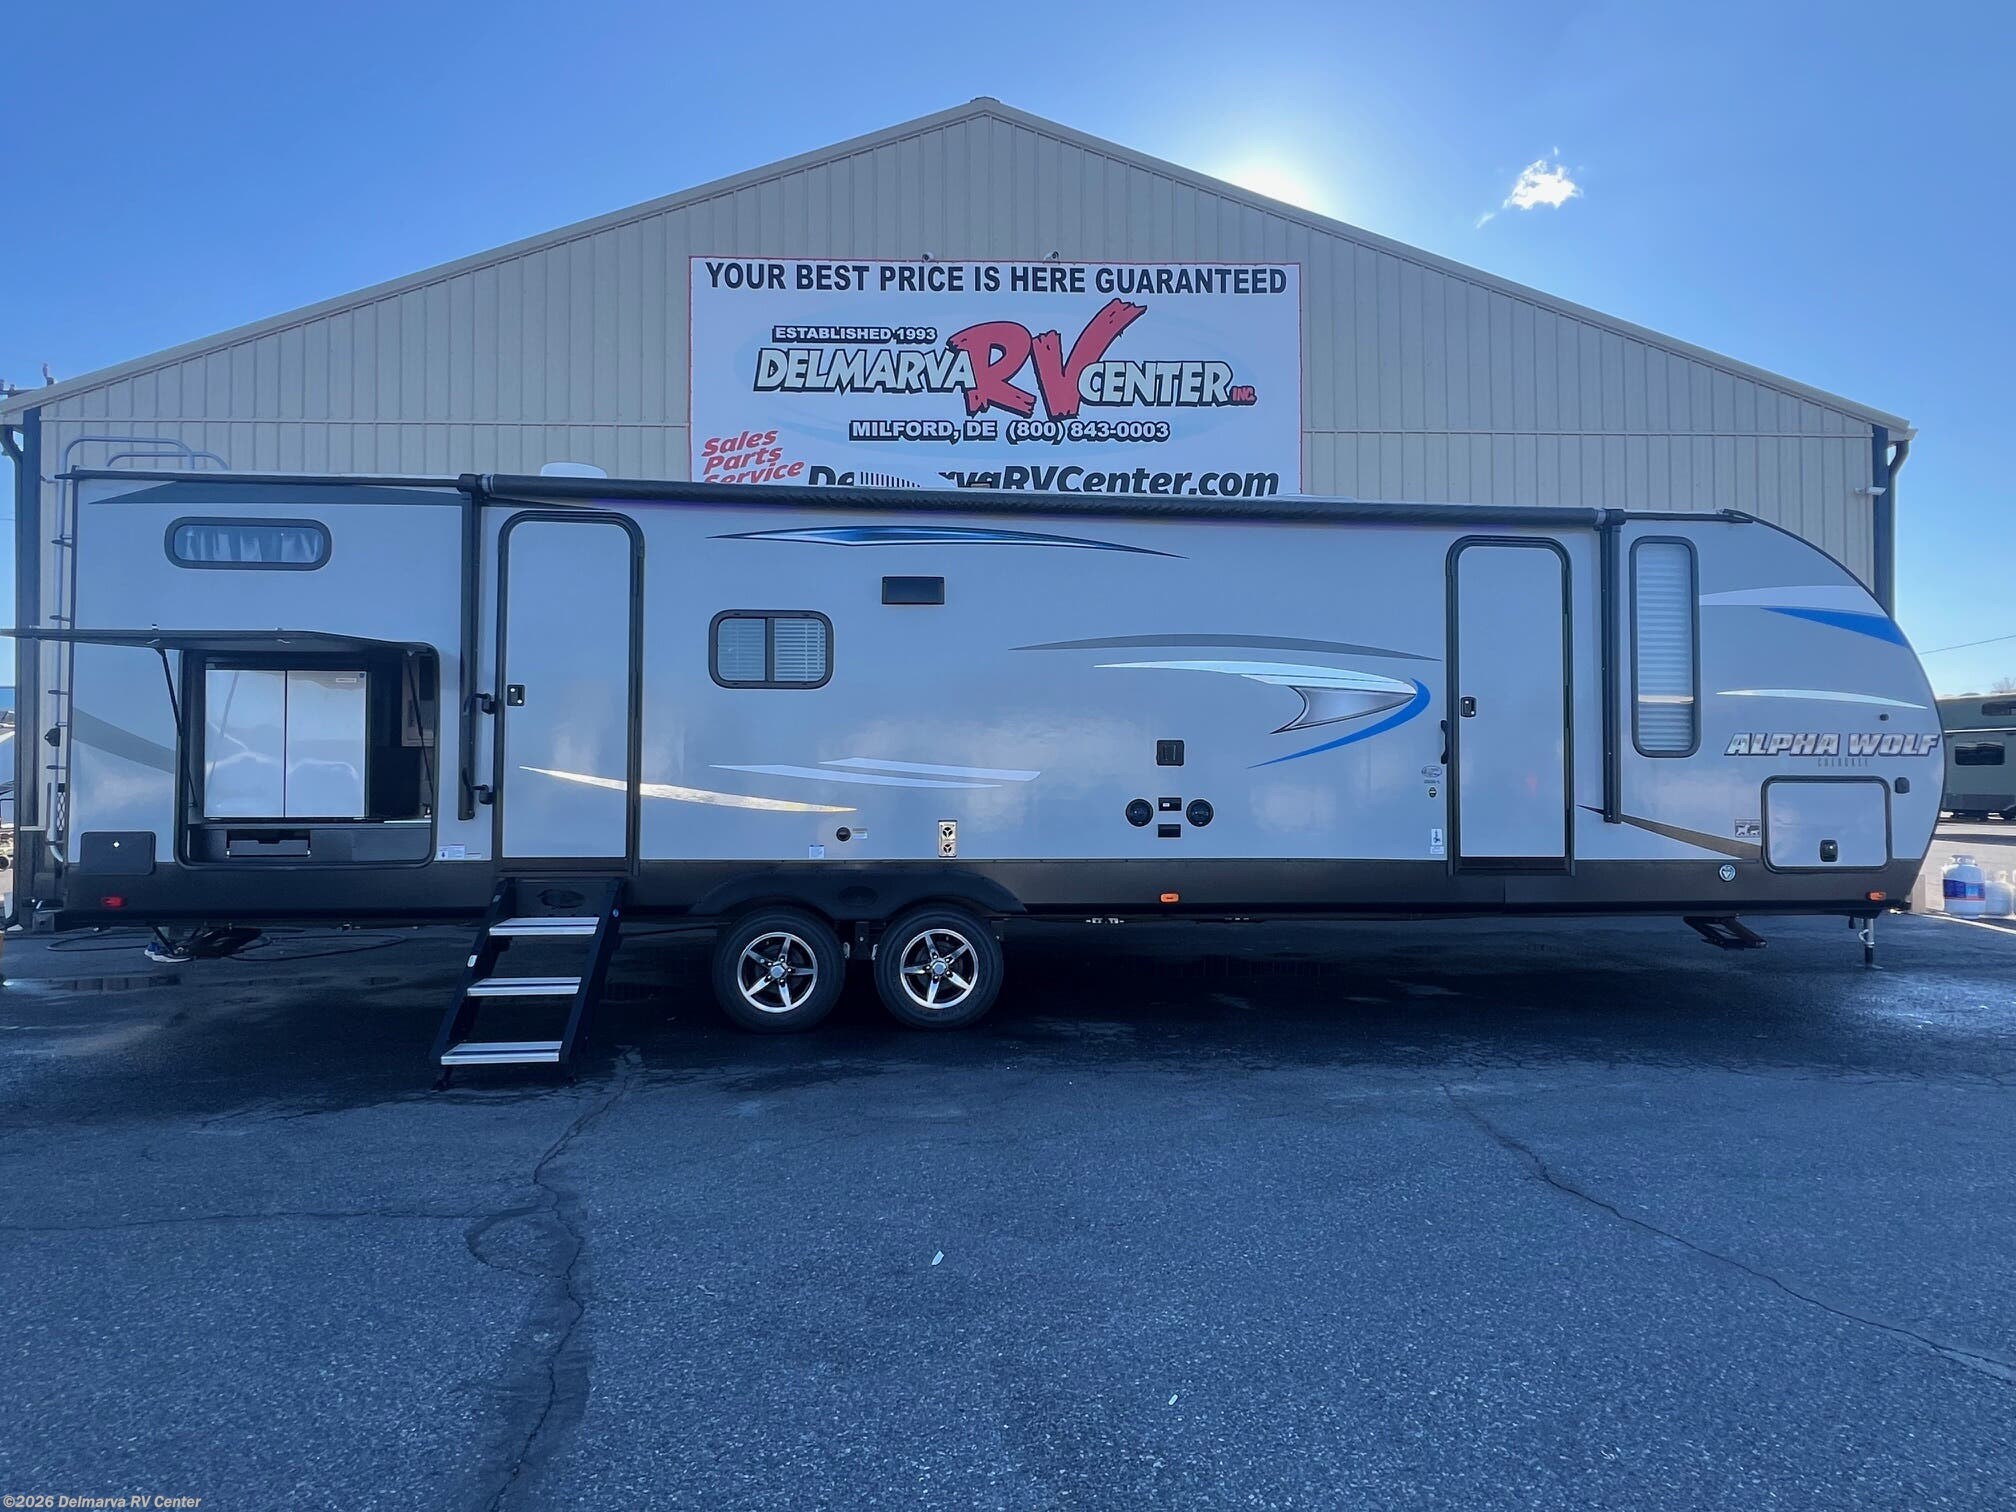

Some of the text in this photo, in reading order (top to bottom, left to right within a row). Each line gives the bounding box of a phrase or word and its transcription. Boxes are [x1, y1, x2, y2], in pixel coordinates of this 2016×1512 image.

[705, 262, 1287, 294] YOUR BEST PRICE IS HERE GUARANTEED
[773, 326, 937, 343] ESTABLISHED 1993
[754, 348, 977, 394] DELMARVA
[946, 298, 1147, 420] RV
[1078, 361, 1233, 407] CENTER
[701, 430, 778, 457] Sales
[850, 420, 1170, 444] MILFORD, DE (800) 843-0003
[703, 447, 783, 475] Parts
[808, 465, 1279, 497] DevaRVCenter.com
[1724, 732, 1941, 757] ALPHA WOLF
